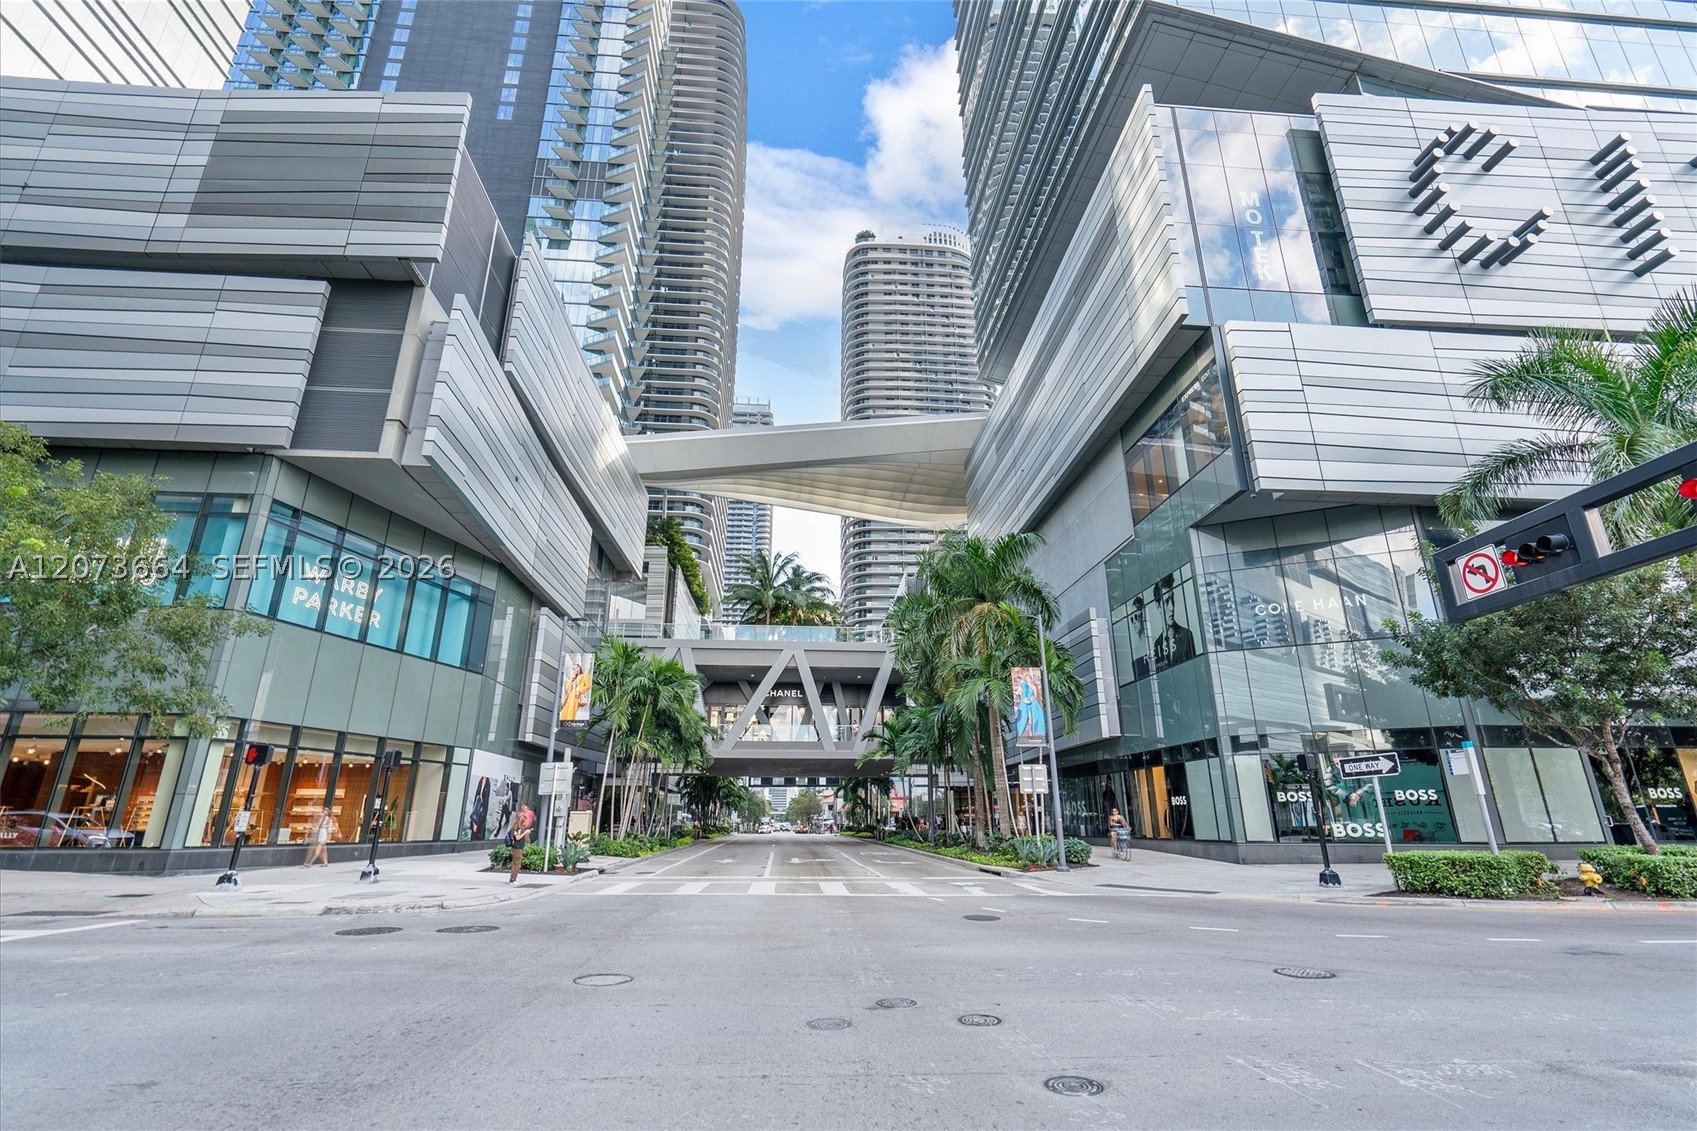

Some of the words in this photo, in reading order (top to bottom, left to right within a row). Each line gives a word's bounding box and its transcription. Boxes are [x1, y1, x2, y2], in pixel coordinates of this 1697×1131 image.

[1239, 191, 1274, 281] MOTEK
[292, 586, 382, 629] PARKER
[1255, 600, 1304, 616] COLE
[1313, 593, 1368, 611] HAAN
[1348, 763, 1364, 772] ONE
[1365, 761, 1380, 770] WAY
[1276, 791, 1313, 802] BOSS
[1394, 789, 1438, 801] BOSS
[1647, 787, 1683, 799] BOSS
[1171, 795, 1187, 806] BOSS
[1066, 800, 1087, 816] BOSS
[1332, 822, 1386, 838] BOSS
